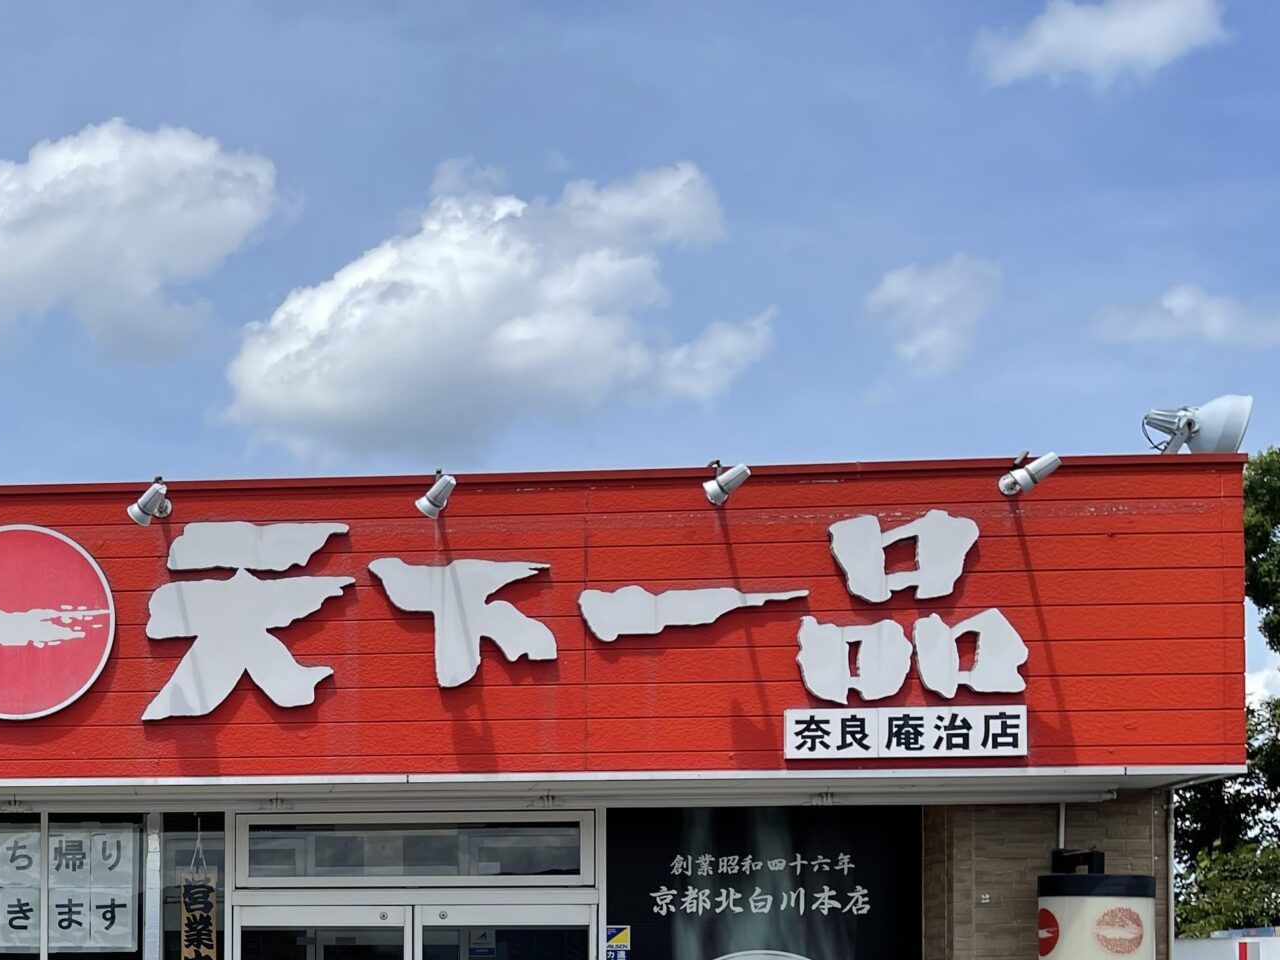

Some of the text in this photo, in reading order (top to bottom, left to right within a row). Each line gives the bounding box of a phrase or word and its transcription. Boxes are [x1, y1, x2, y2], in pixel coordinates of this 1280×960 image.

[141, 508, 1030, 722] 天下一品
[793, 711, 1021, 752] 奈良庵治店
[670, 852, 855, 876] 創業昭和四十六年
[649, 885, 871, 917] 京都北白川本店
